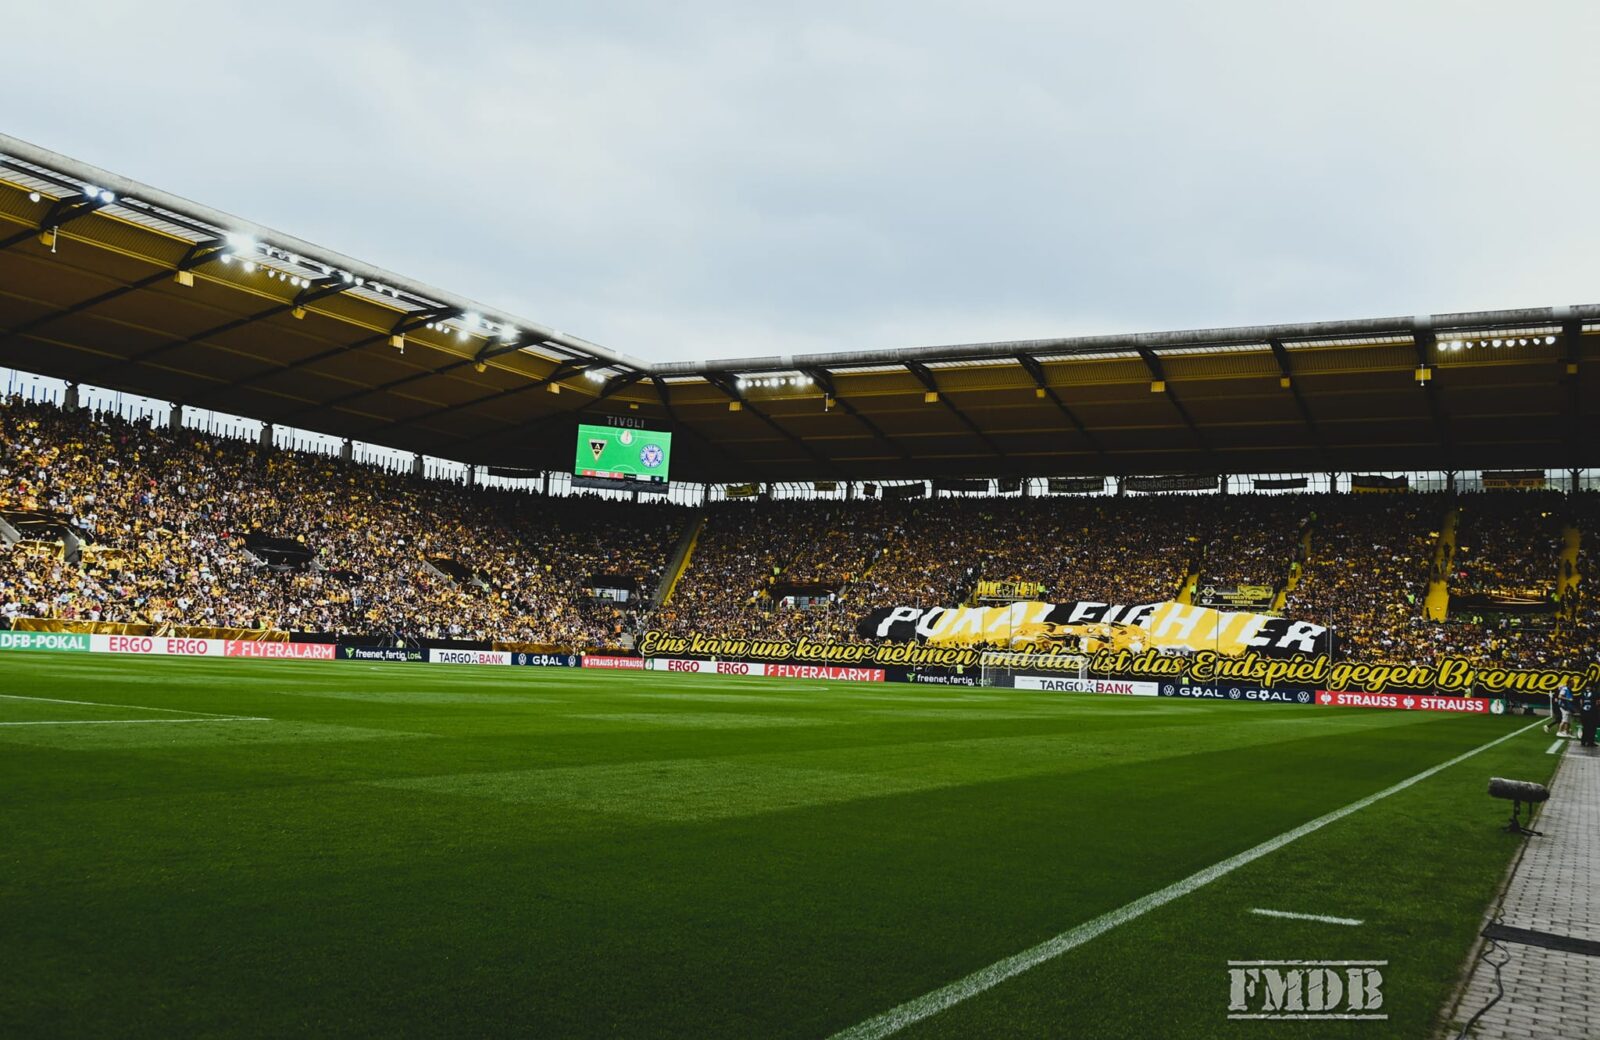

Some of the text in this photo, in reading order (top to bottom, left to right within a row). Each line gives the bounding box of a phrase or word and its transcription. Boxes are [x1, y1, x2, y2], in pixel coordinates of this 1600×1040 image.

[606, 416, 645, 429] TIVOLI
[0, 633, 87, 650] DFB-POKAL
[108, 636, 208, 655] ERGO ERGO
[241, 642, 333, 659] FLYERALARM
[640, 631, 690, 654] Eins
[690, 632, 749, 656] kann
[750, 641, 797, 658] uns
[796, 635, 873, 660] keiner
[876, 640, 977, 665] nehmen
[980, 645, 1036, 669] und
[1036, 645, 1089, 670] das
[1092, 648, 1132, 672] ist
[1133, 650, 1190, 674] das
[1191, 651, 1329, 687] Endspiel
[1330, 663, 1436, 691] gegen
[667, 660, 749, 675] ERGO ERGO
[777, 665, 871, 682] FLYERALARM
[1337, 693, 1484, 711] STRAUSS STRAUSS
